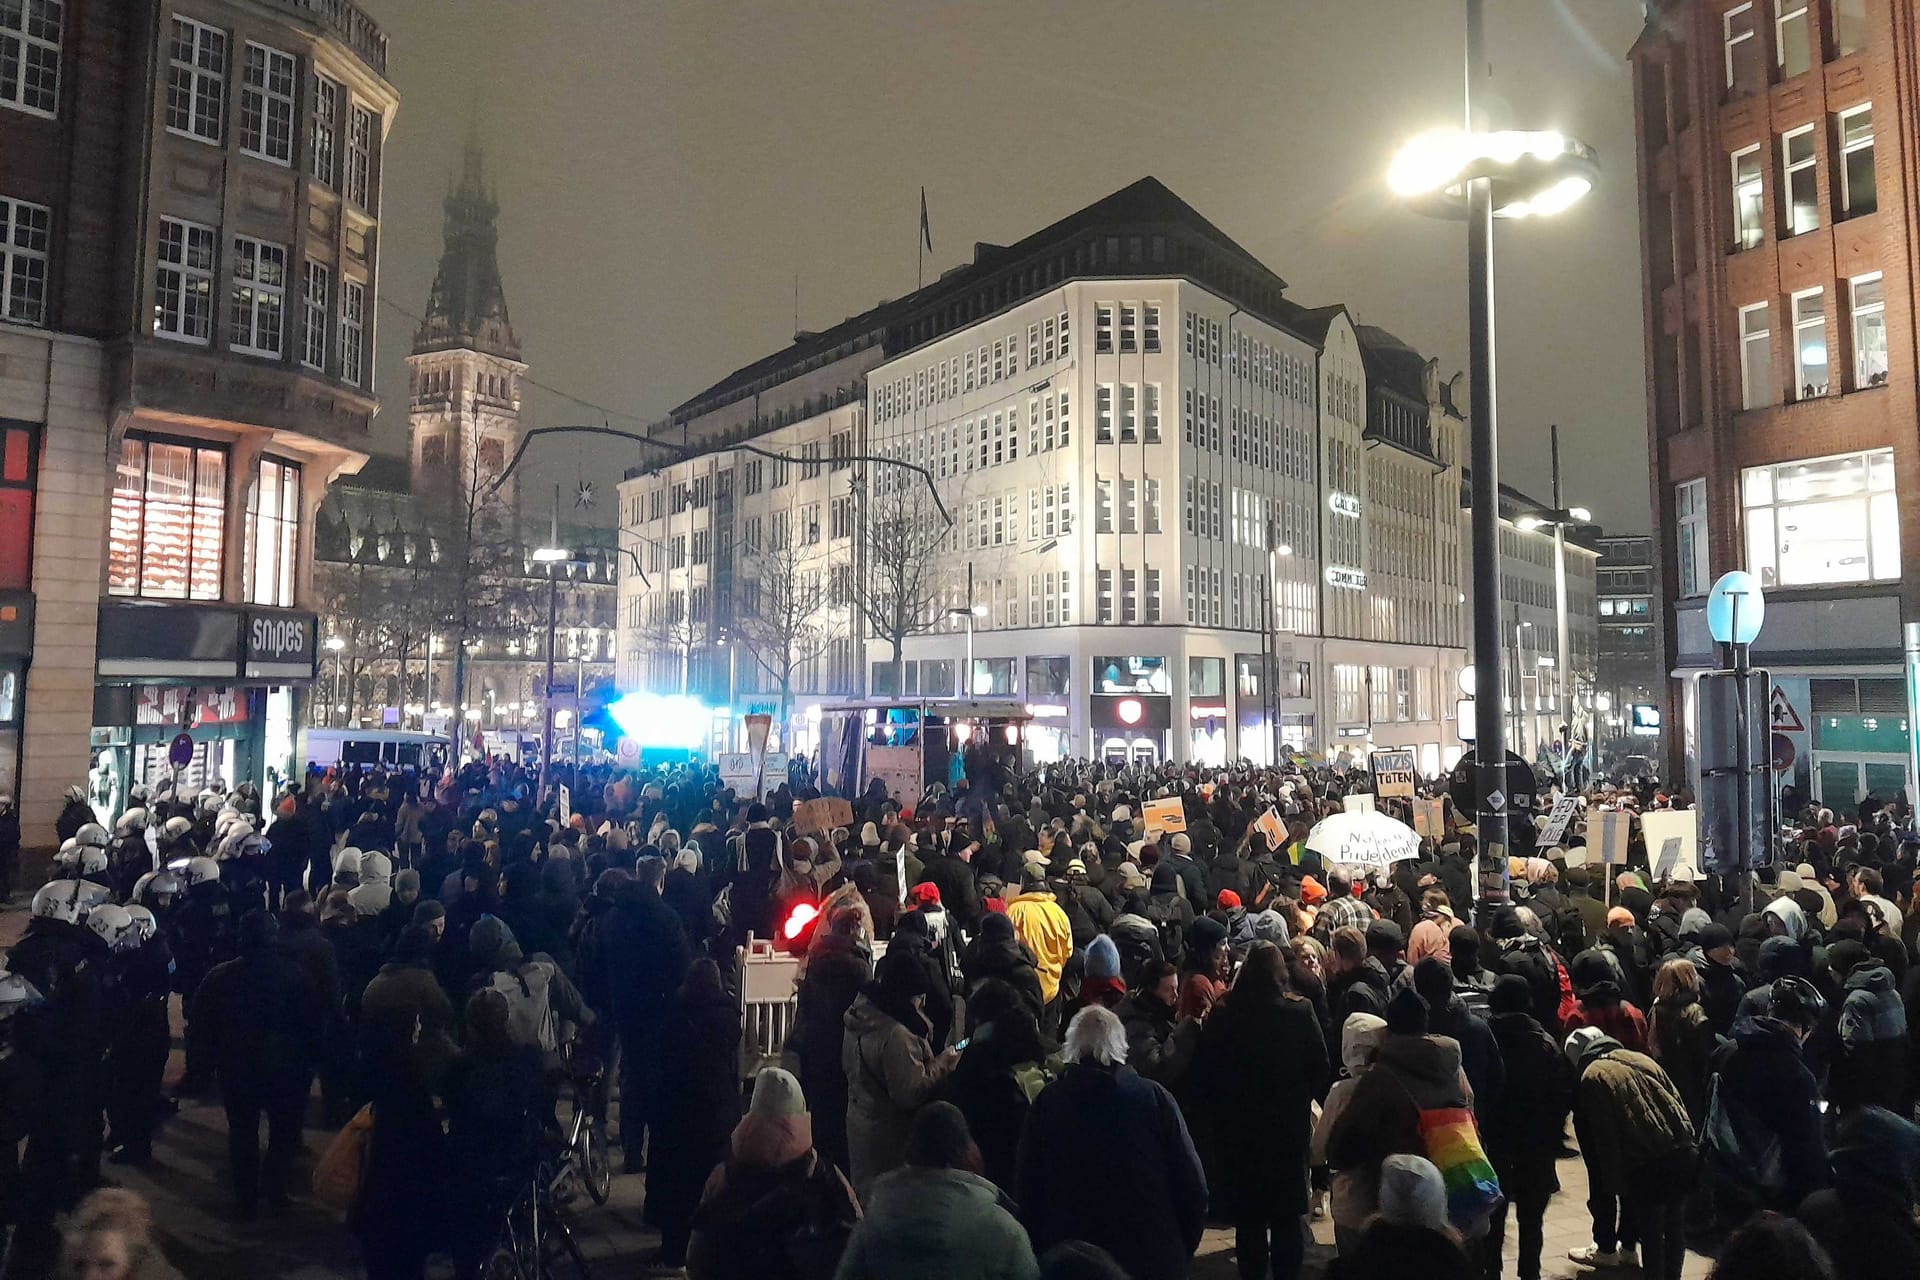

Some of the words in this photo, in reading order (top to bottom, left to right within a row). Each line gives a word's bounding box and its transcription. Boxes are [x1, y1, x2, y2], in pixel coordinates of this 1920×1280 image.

[252, 618, 303, 659] snipes
[1374, 753, 1412, 771] NAZIS
[1377, 772, 1412, 784] TÖTEN
[1340, 844, 1380, 863] Pride
